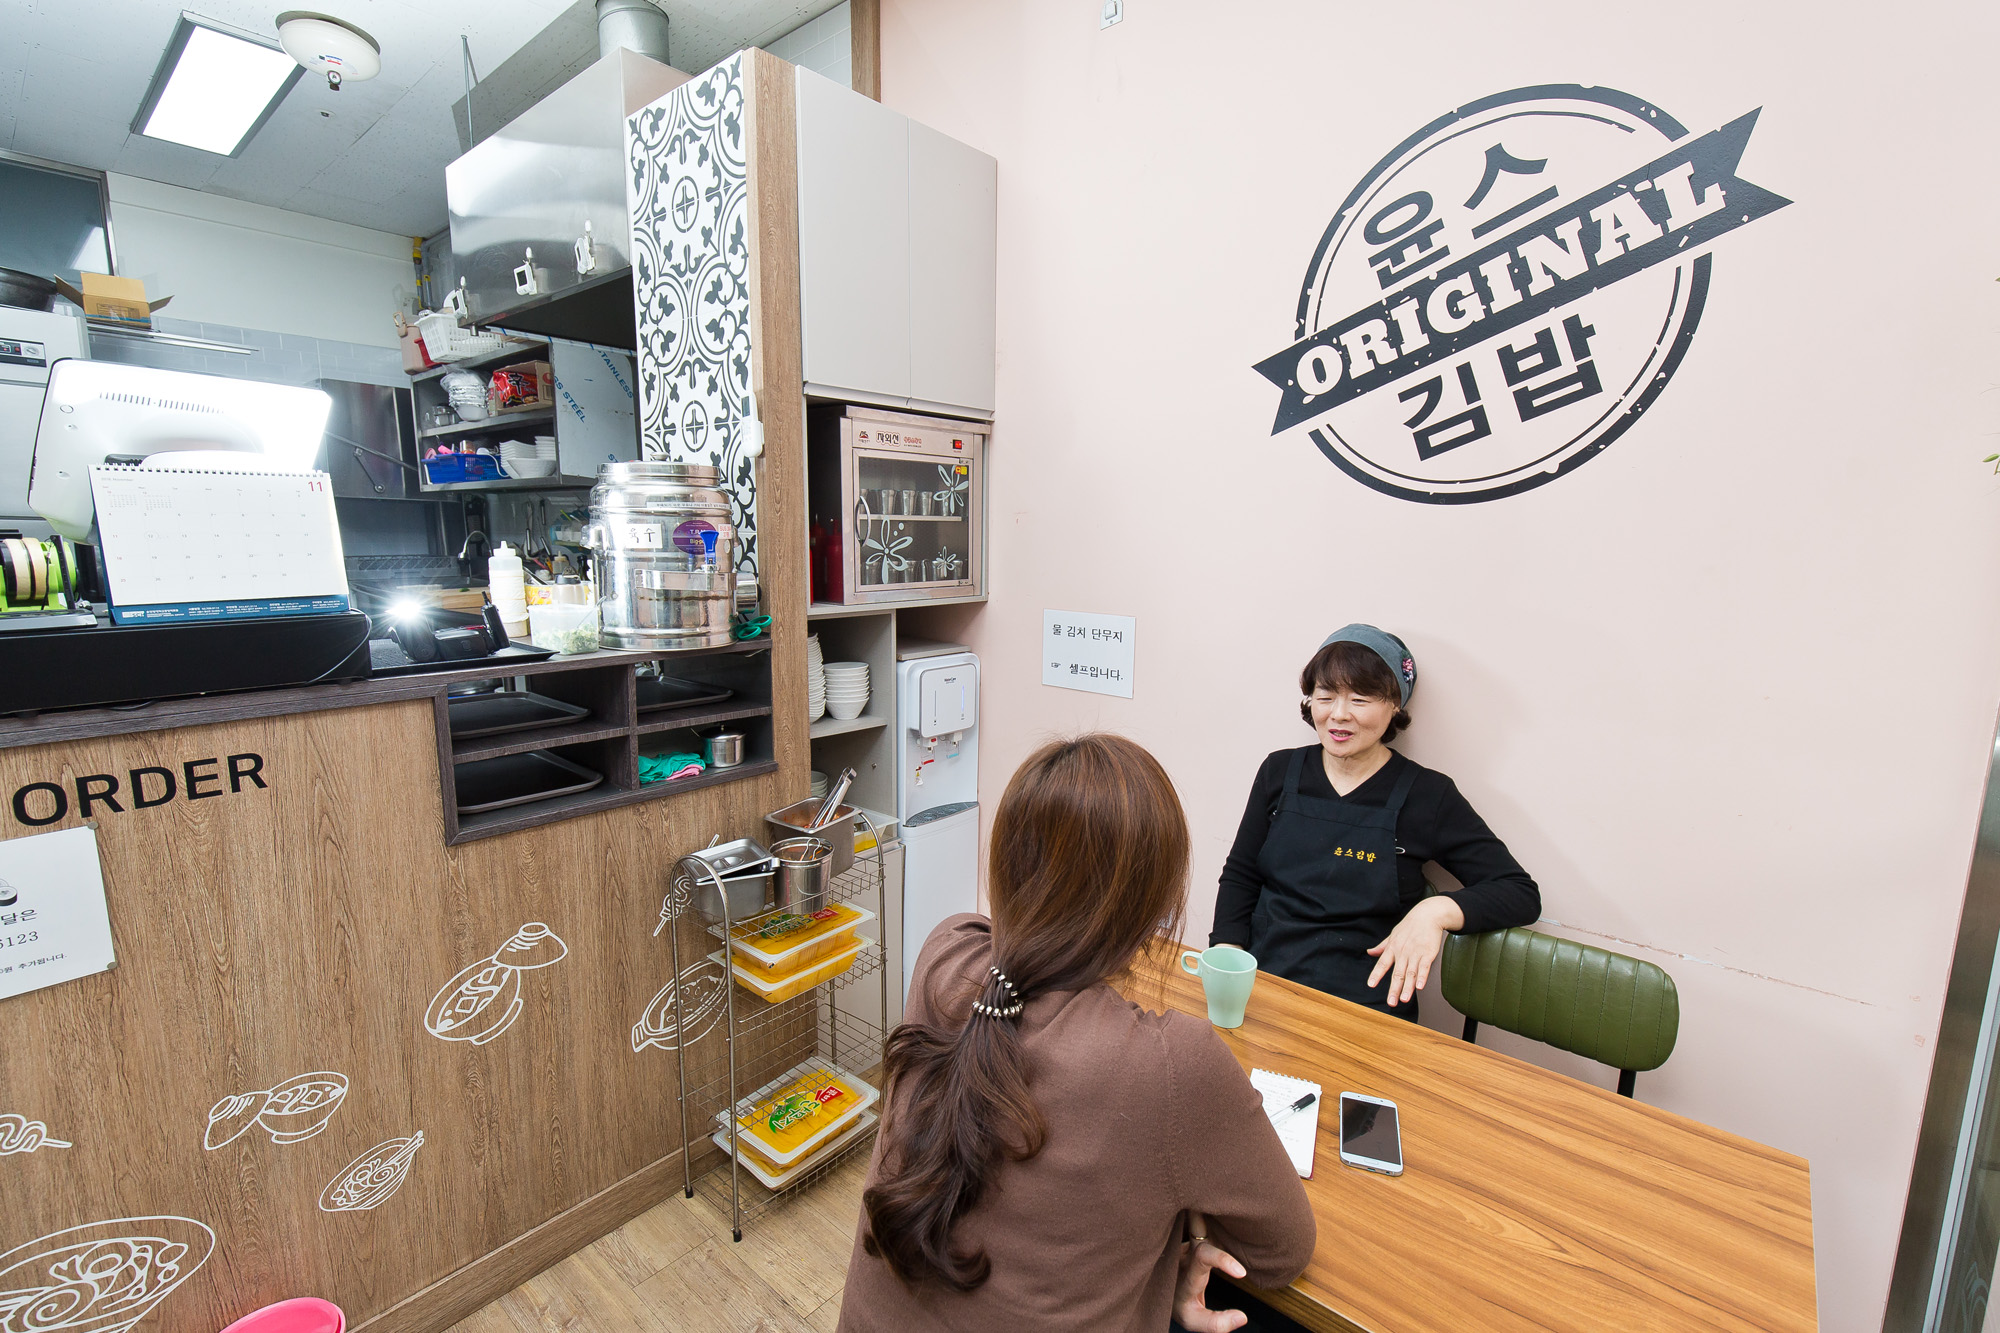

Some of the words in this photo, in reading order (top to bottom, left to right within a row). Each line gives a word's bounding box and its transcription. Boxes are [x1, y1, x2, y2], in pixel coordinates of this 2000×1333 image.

[1363, 142, 1560, 290] 윤스
[1296, 160, 1727, 398] ORIGINAL
[597, 349, 634, 399] TAINLESS
[1397, 313, 1604, 462] 김밥
[562, 391, 586, 424] STEEL
[308, 481, 323, 492] 11
[1052, 623, 1062, 636] 물
[1066, 625, 1086, 639] 김치
[1091, 628, 1123, 643] 단무지
[1069, 663, 1124, 681] 셀프입니다.
[12, 752, 268, 827] ORDER
[18, 953, 68, 969] 추가됩니다.
[772, 1100, 821, 1130] 단무지
